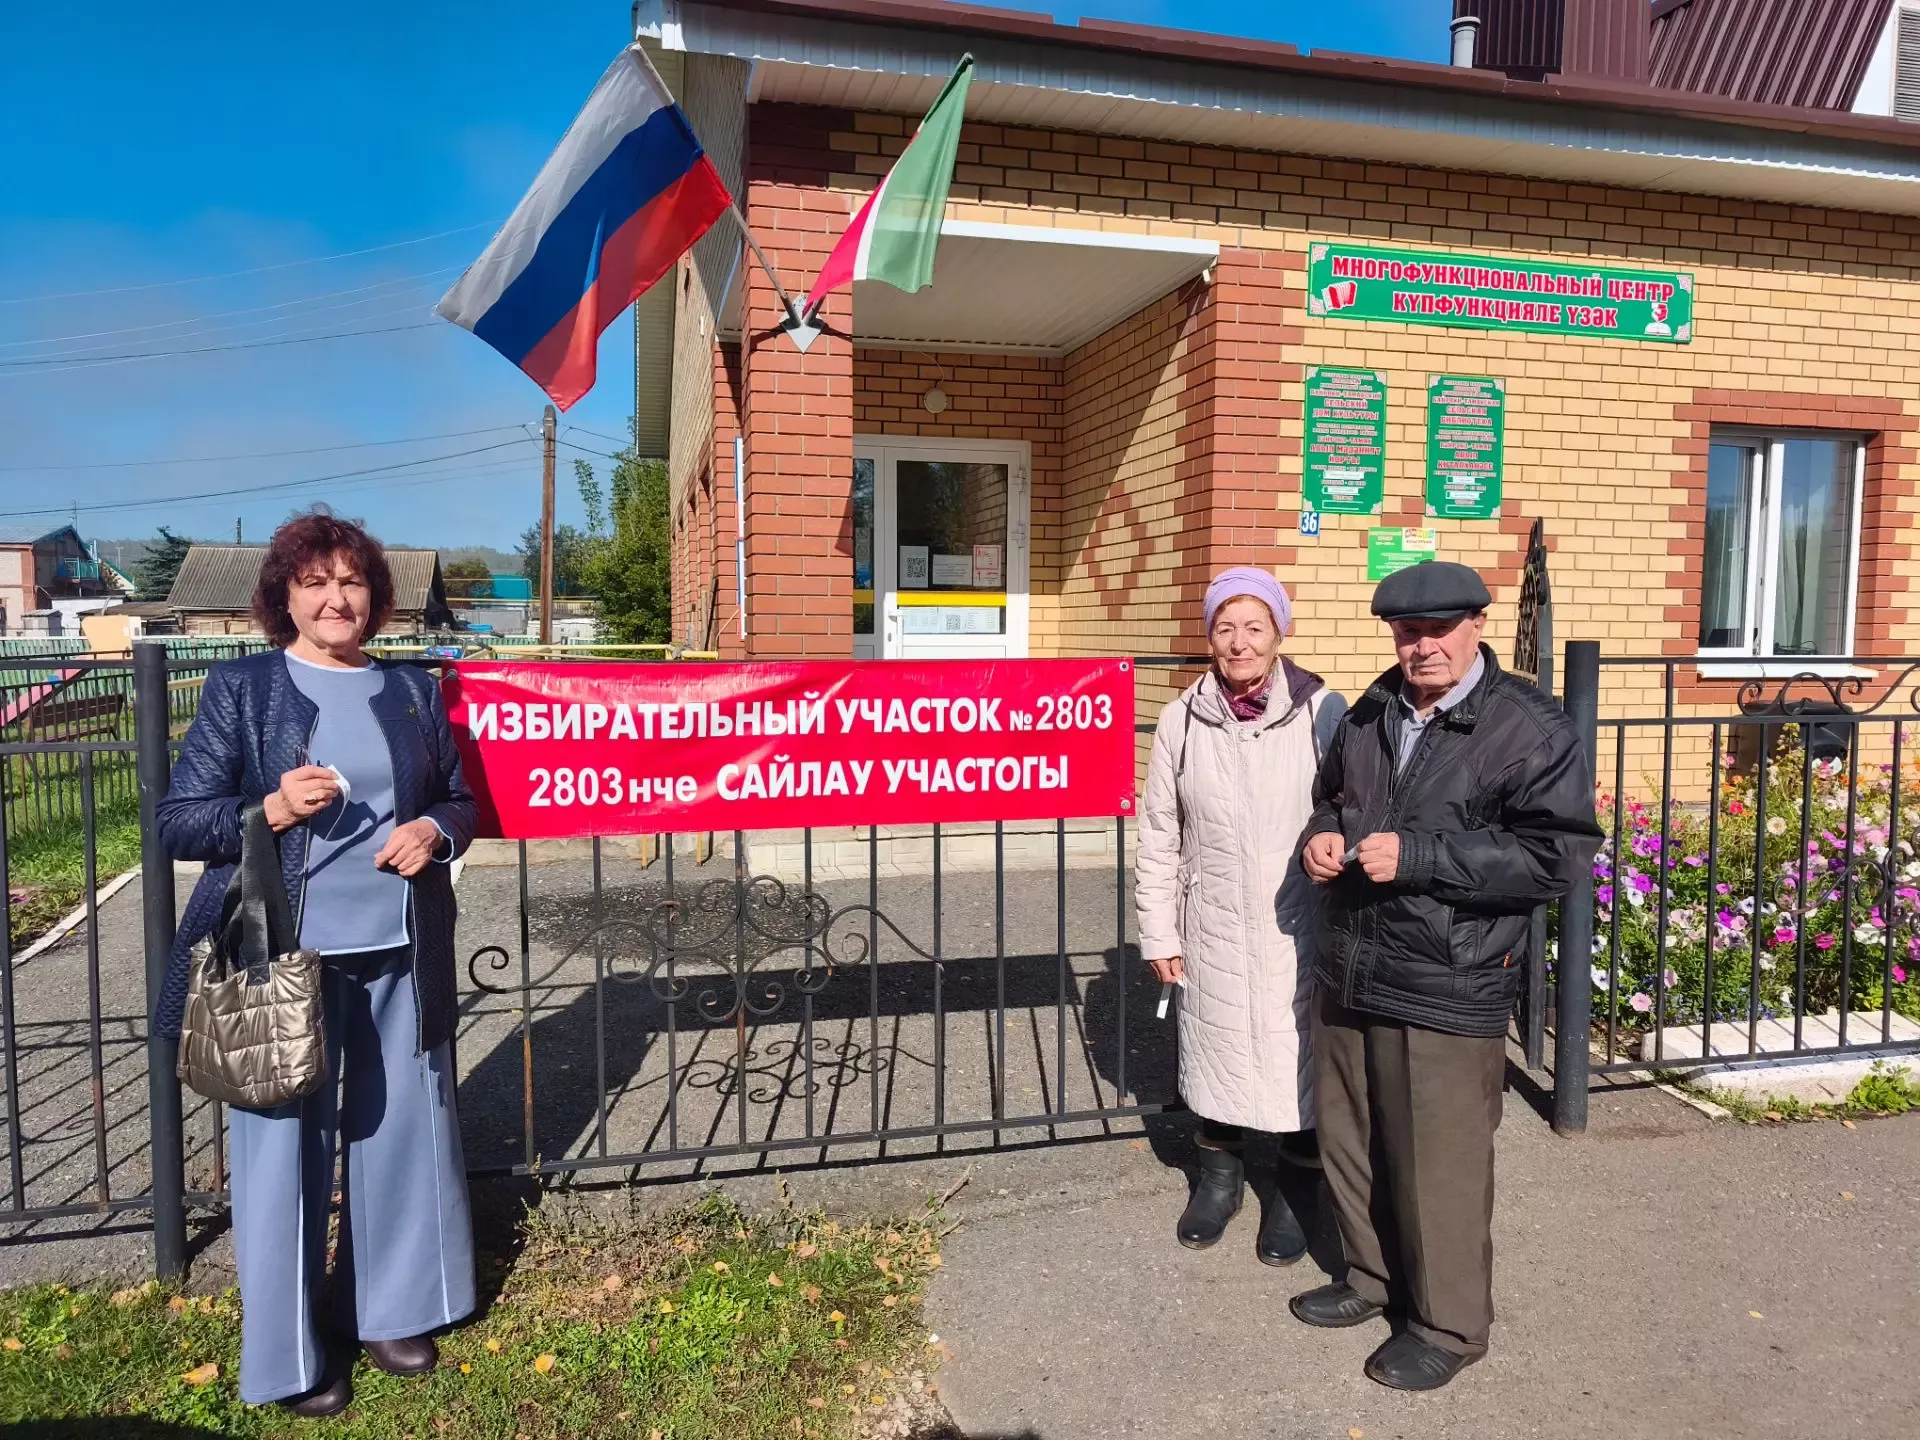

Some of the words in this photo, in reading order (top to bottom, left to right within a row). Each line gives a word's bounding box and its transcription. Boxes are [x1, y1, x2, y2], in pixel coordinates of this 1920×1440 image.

[1332, 256, 1603, 298] МНОГОФУНКЦИОНАЛЬНЫЙ
[1608, 279, 1675, 303] ЦЕНТР
[1393, 291, 1561, 324] КҮПФУНКЦИЯЛЕ
[1312, 408, 1331, 417] ДОМ
[1332, 409, 1379, 420] КУЛЬТУРЫ
[1440, 416, 1492, 426] БИБЛИОТЕКА
[1302, 511, 1318, 533] 36
[467, 691, 825, 741] ИЗБИРАТЕЛЬНЫЙ
[835, 697, 1003, 734] УЧАСТОК
[528, 766, 624, 807] 2803
[628, 775, 698, 804] нче
[716, 754, 874, 801] САЙЛАУ
[881, 755, 1068, 794] УЧАСТОГЫ
